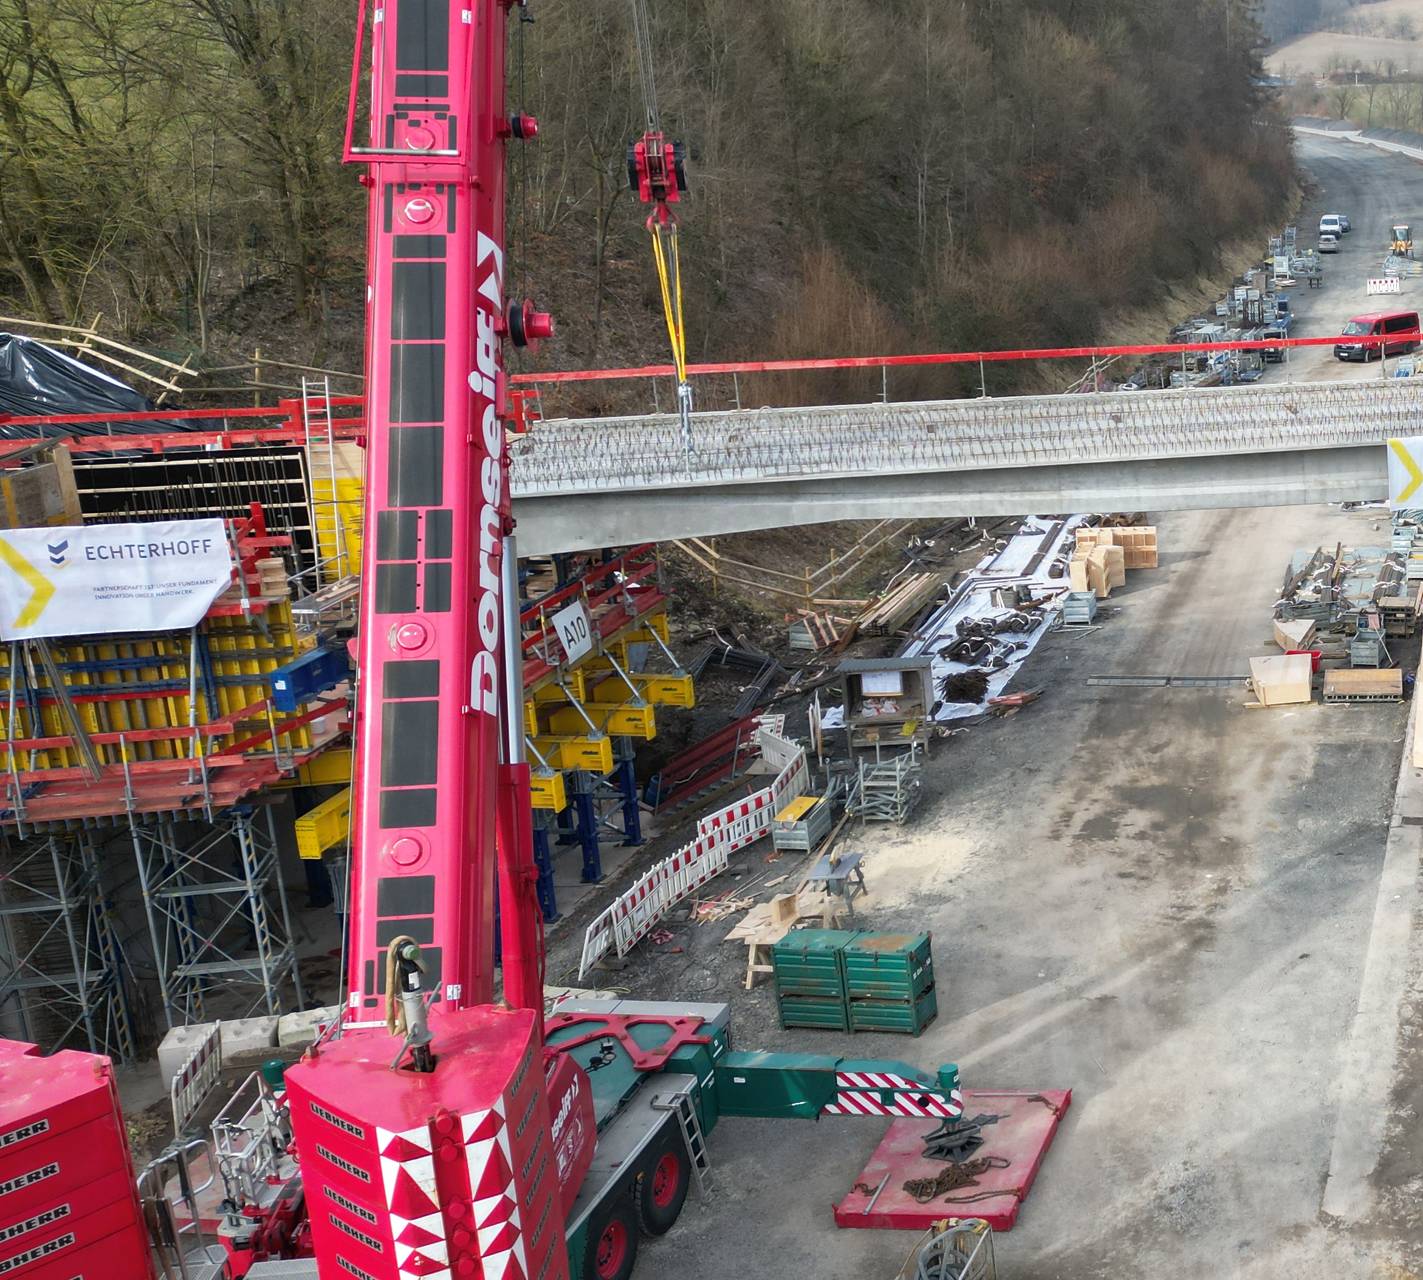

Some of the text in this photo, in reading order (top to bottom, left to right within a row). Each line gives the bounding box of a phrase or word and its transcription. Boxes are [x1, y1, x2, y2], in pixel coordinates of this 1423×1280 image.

[85, 539, 212, 561] ECHTERHOFF
[563, 616, 587, 649] A10
[311, 1103, 364, 1138] LIEBHERR
[317, 1145, 370, 1181] LIEBHERR
[324, 1187, 376, 1223] LIEBHERR
[330, 1216, 382, 1251] LIEBHERR
